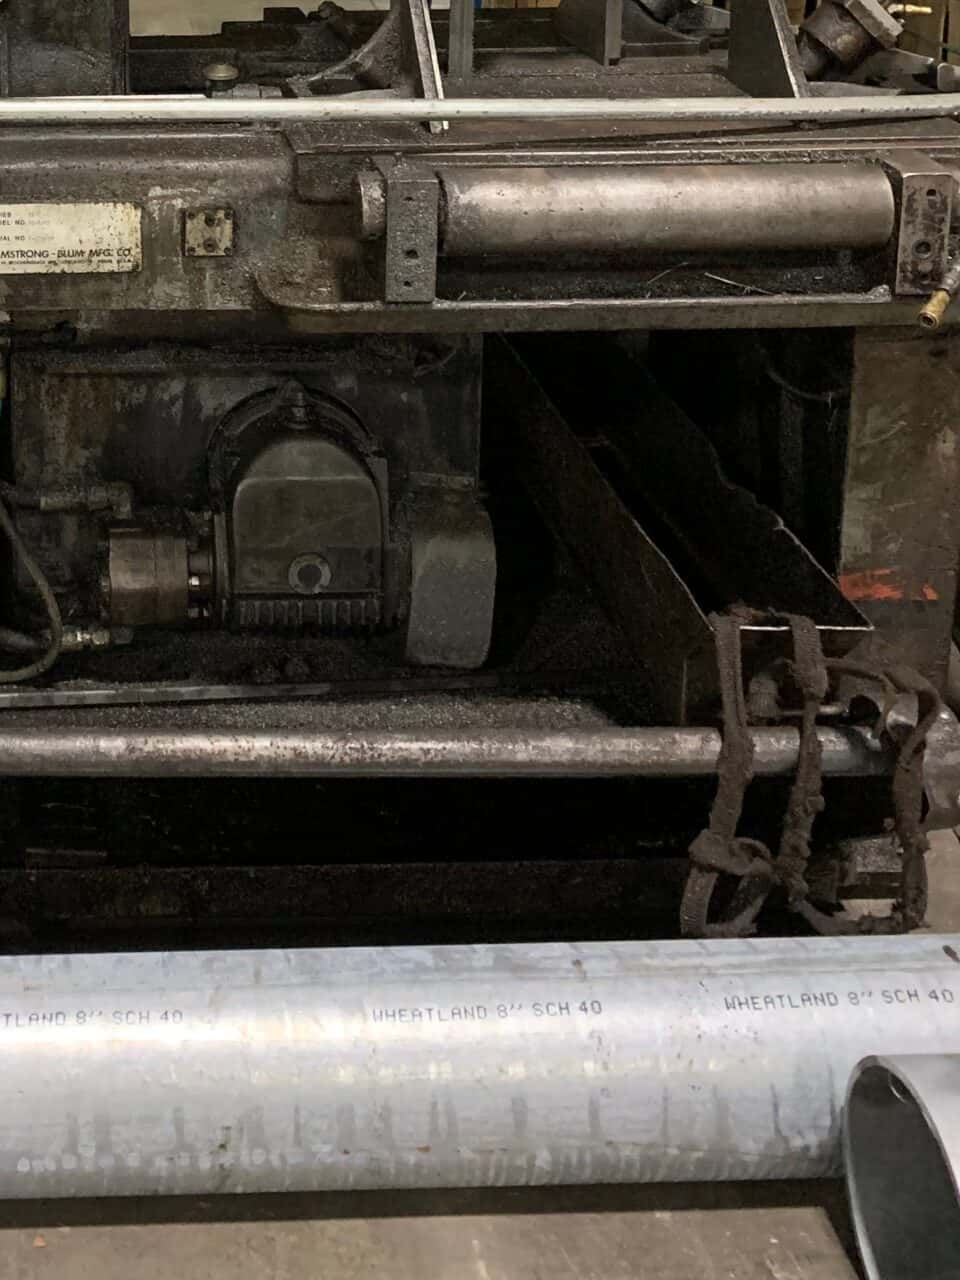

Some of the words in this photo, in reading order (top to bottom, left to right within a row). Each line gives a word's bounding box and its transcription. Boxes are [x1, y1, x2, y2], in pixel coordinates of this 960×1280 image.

[373, 1005, 488, 1023] WHEATLAND
[531, 1000, 571, 1017] SCH
[578, 999, 603, 1015] 40
[724, 991, 839, 1011] WHEATLAND
[882, 988, 921, 1004] SCH
[928, 988, 954, 1003] 40
[111, 1009, 150, 1025] SCH
[159, 1009, 183, 1024] 40
